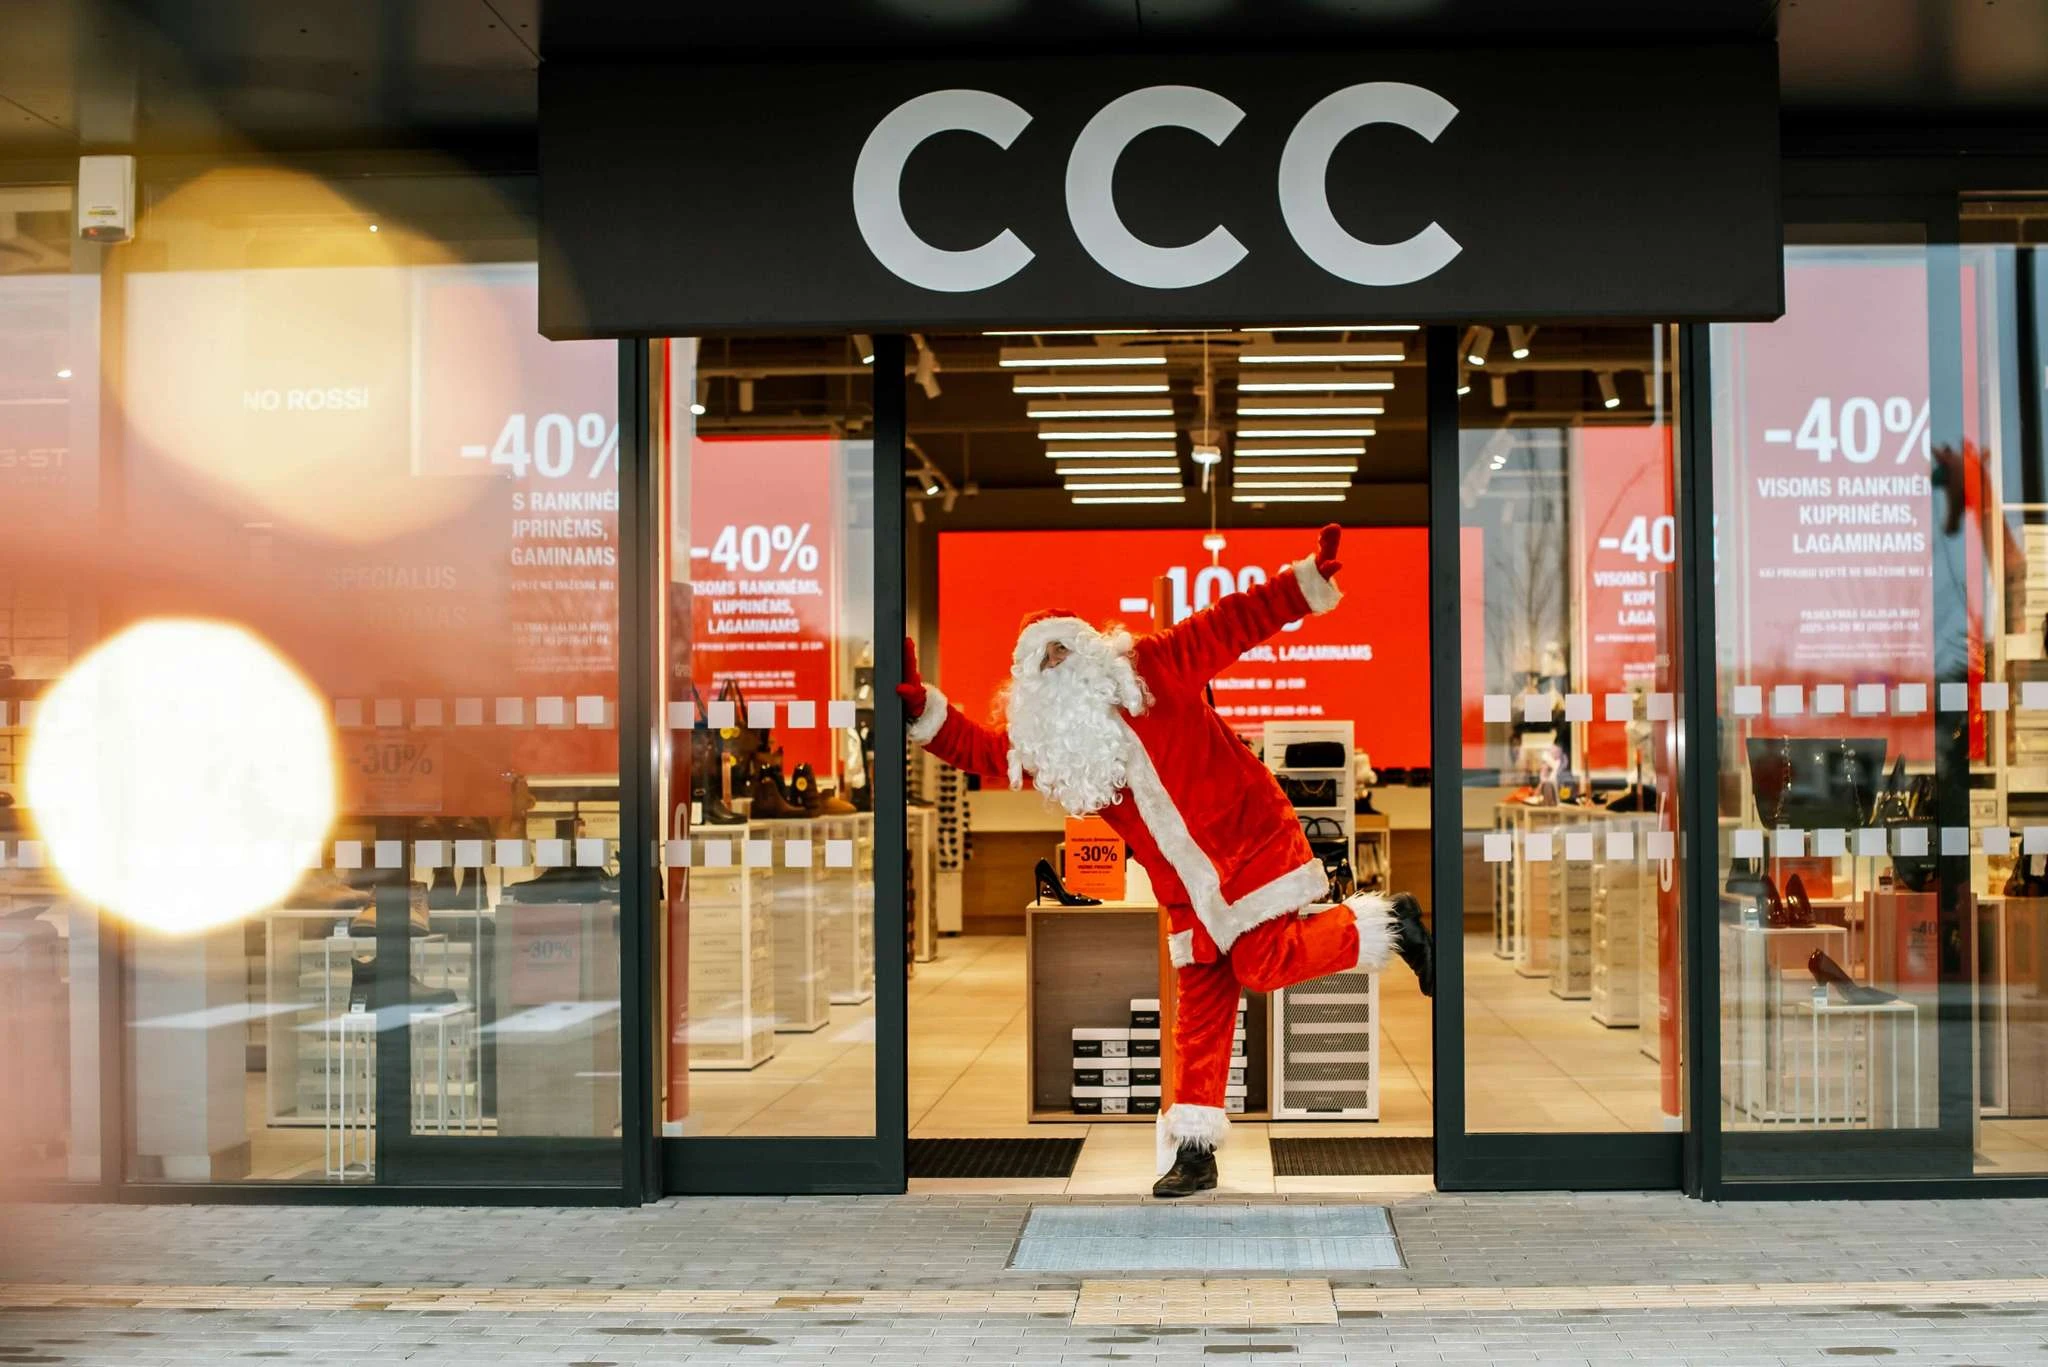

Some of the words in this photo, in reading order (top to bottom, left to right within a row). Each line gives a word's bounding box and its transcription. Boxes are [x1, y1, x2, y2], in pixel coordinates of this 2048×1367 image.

[852, 81, 1464, 292] CCC
[287, 385, 369, 410] ROSSI
[1764, 396, 1931, 465] -40%
[461, 413, 618, 478] -40%
[1758, 477, 1832, 498] VISOMS
[1800, 503, 1918, 527] KUPRINĖMS,
[690, 523, 819, 573] -40%
[1793, 532, 1925, 553] LAGAMINAMS
[708, 618, 800, 634] LAGAMINAMS
[1073, 845, 1118, 863] -30%
